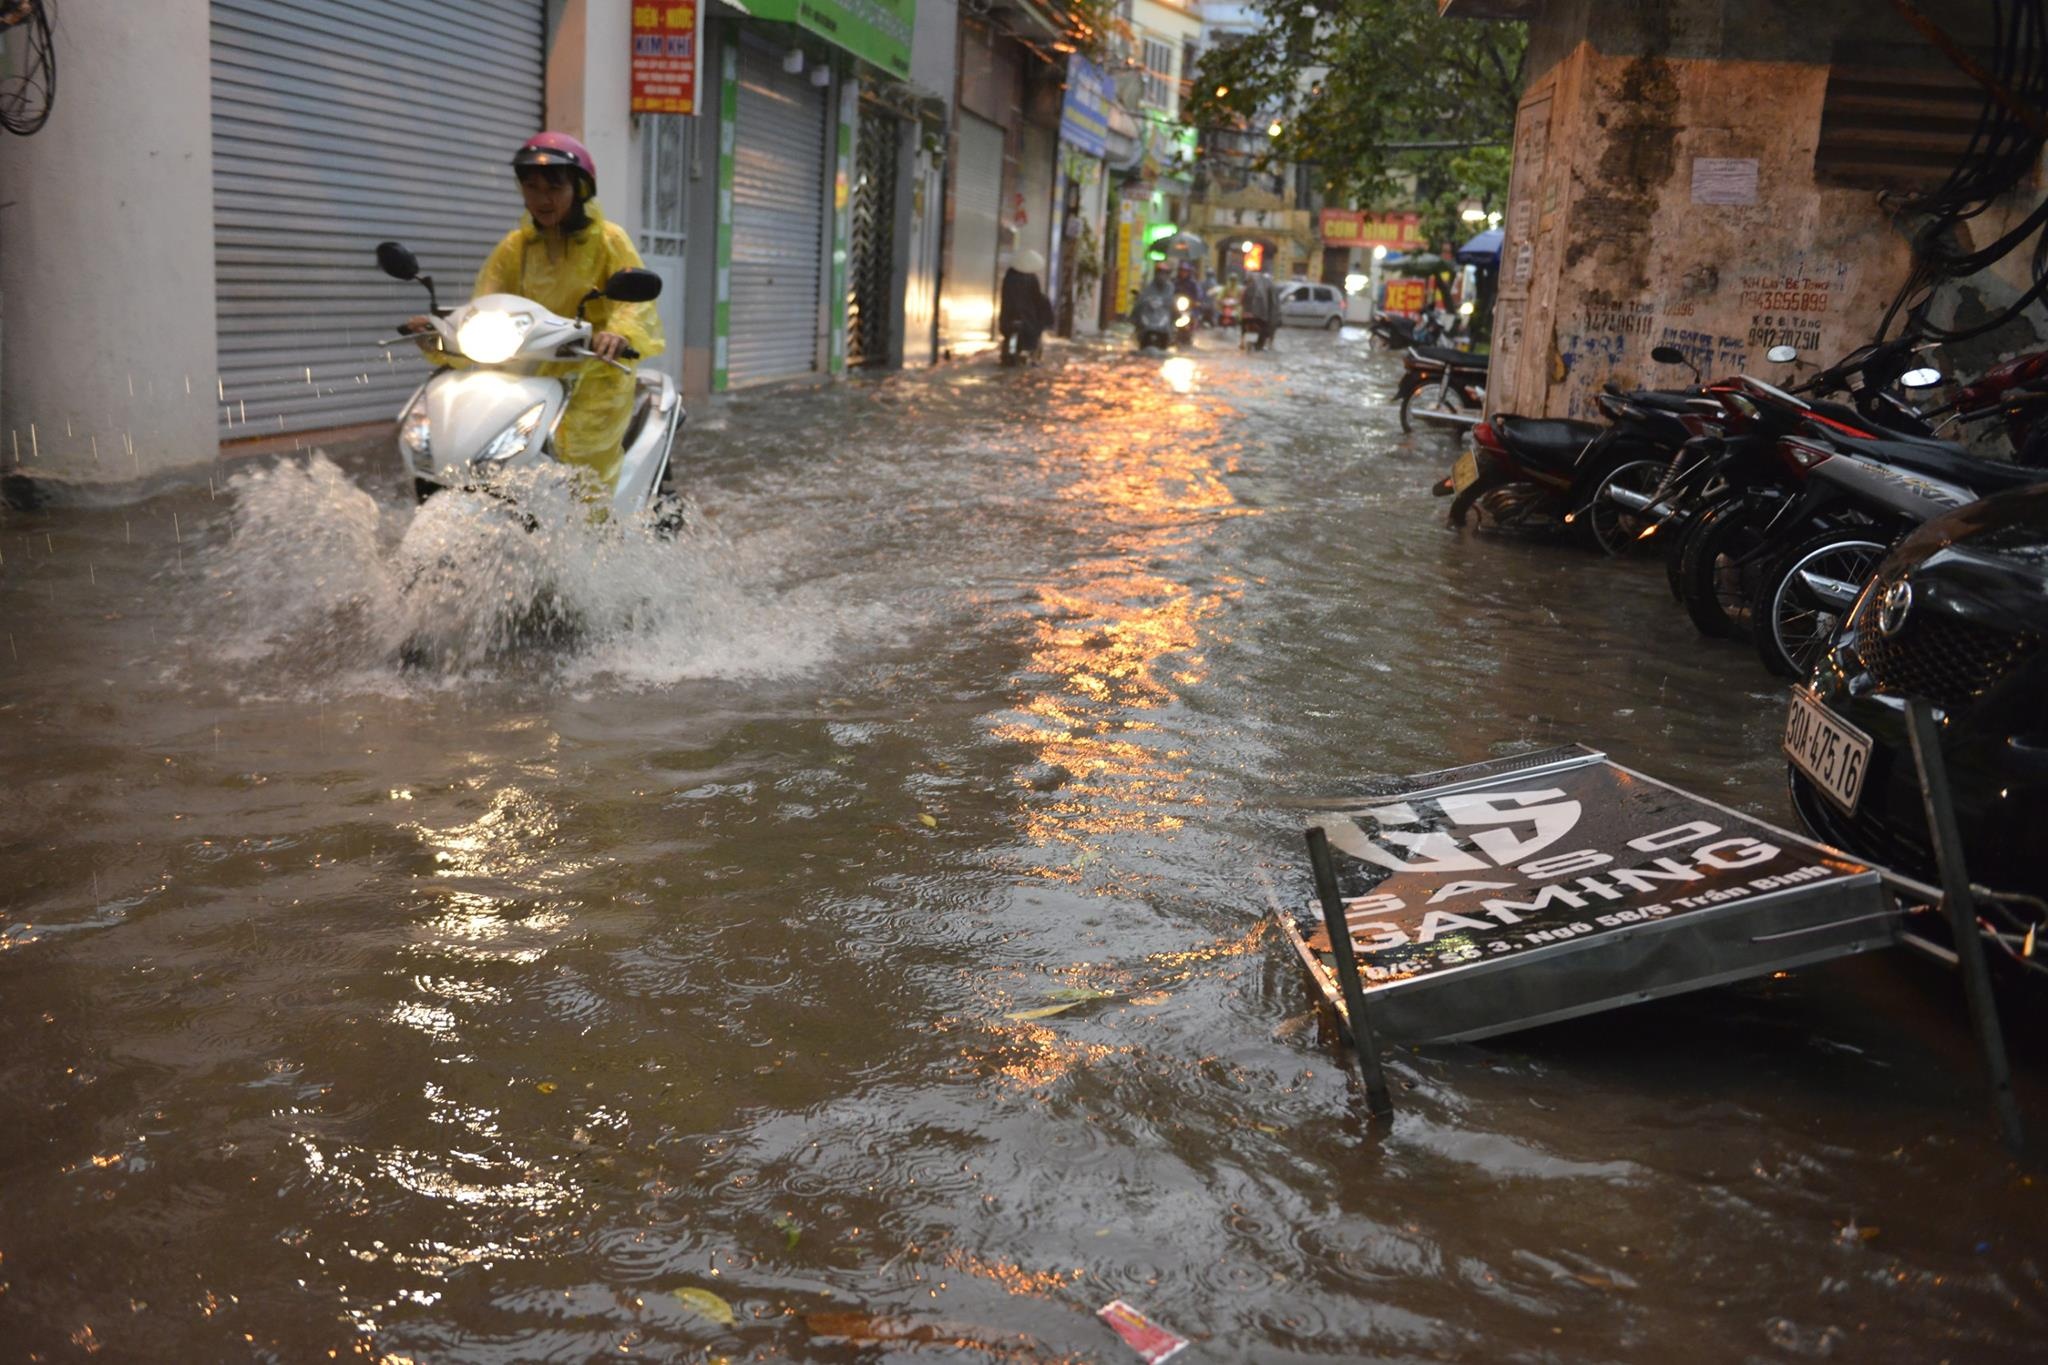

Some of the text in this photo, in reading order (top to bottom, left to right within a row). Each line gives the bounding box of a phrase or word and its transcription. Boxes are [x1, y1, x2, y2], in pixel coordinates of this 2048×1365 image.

[635, 34, 663, 55] KIM
[1387, 284, 1406, 311] XE
[1346, 837, 1782, 953] GAMING
[1594, 902, 1673, 928] 58/5
